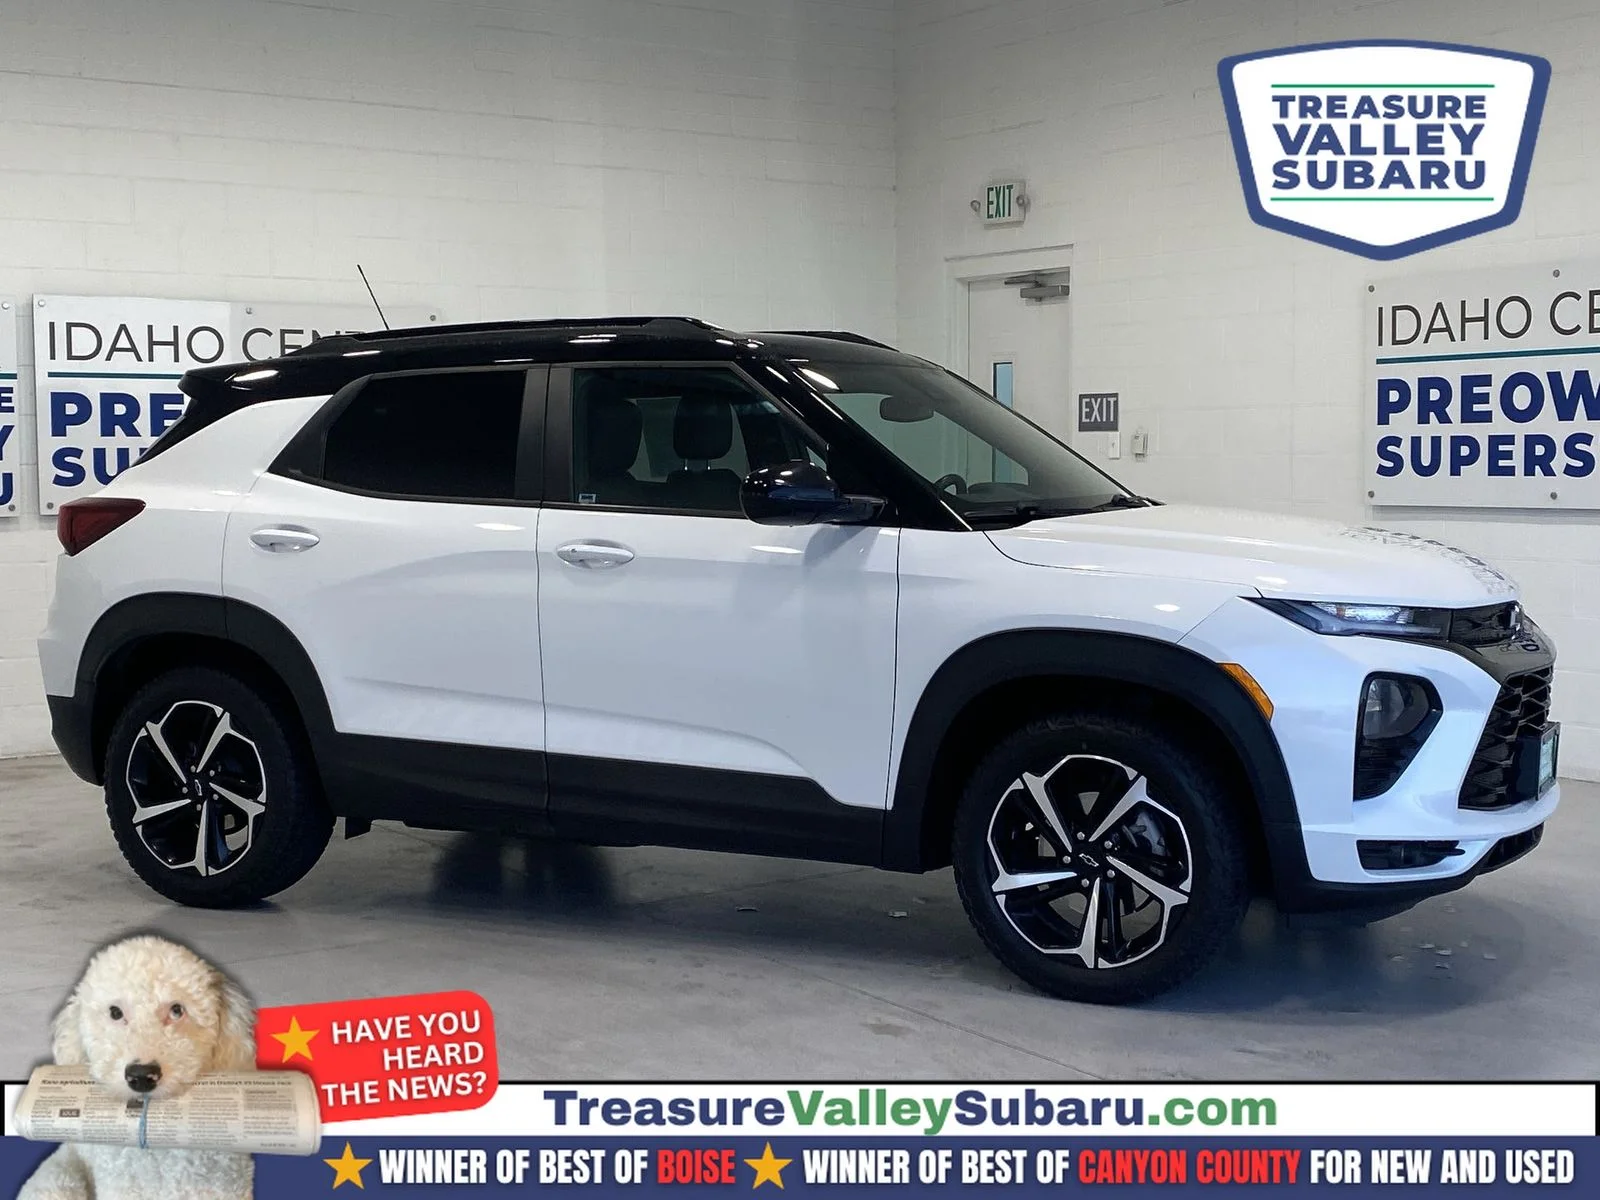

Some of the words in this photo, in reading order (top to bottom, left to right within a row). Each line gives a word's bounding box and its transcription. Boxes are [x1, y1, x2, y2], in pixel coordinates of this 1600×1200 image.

[986, 184, 1014, 219] EXIT
[48, 321, 225, 364] IDAHO
[1377, 295, 1532, 347] IDAHO
[50, 391, 185, 437] PRE
[1081, 396, 1117, 423] EXIT
[1376, 369, 1600, 426] PREOW
[1376, 432, 1596, 478] SUPERS
